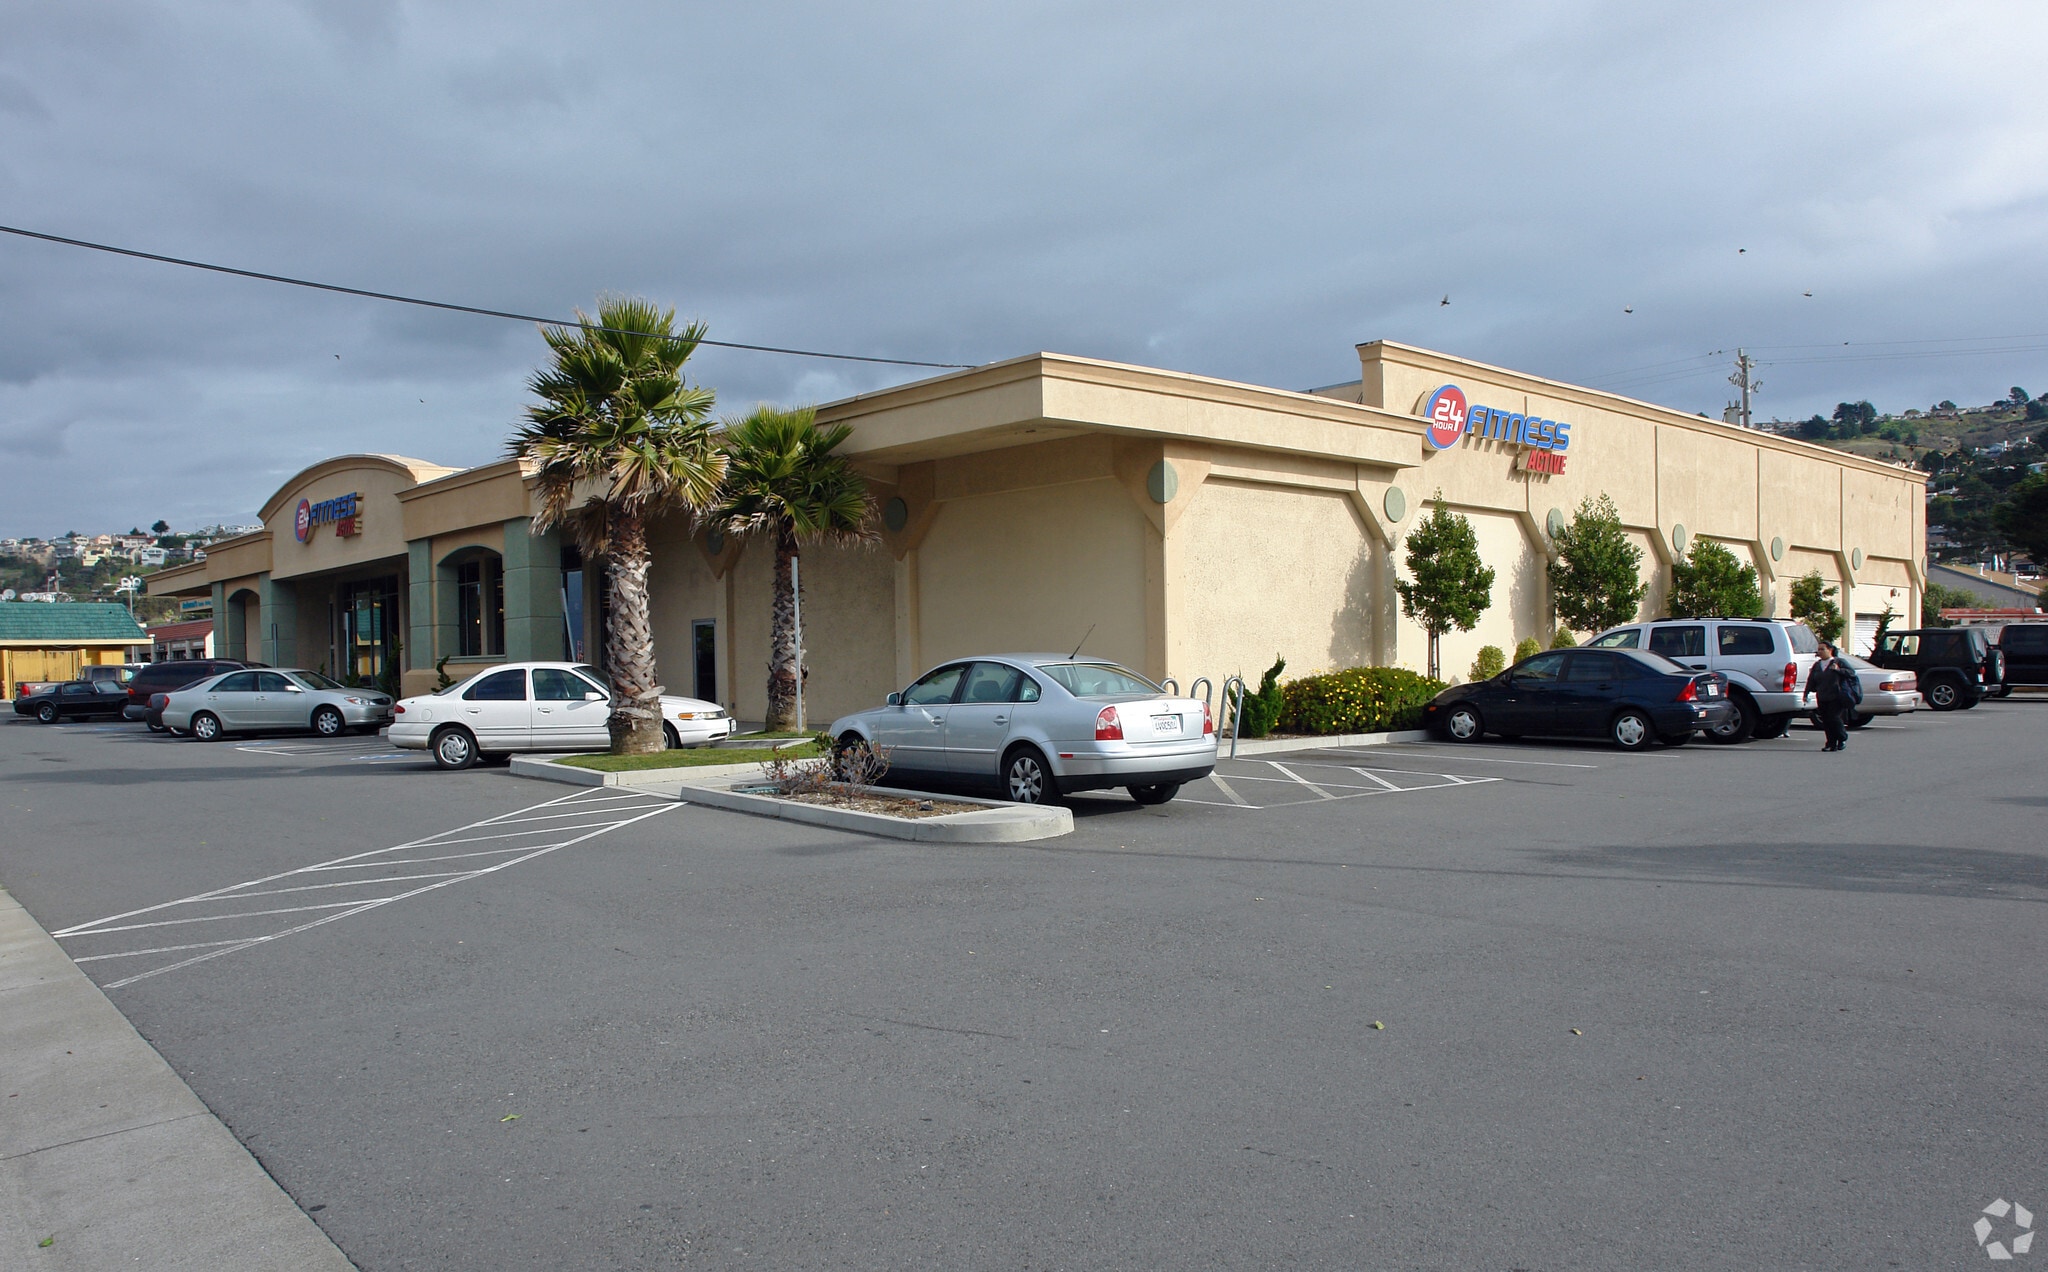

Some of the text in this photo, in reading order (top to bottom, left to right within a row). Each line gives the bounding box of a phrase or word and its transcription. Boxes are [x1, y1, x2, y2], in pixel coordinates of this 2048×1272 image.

[1432, 420, 1454, 431] HOUR
[1434, 397, 1464, 432] 24
[1465, 405, 1571, 450] FITNESS
[1527, 450, 1567, 475] ACTIVE
[310, 492, 357, 526] FITNESS
